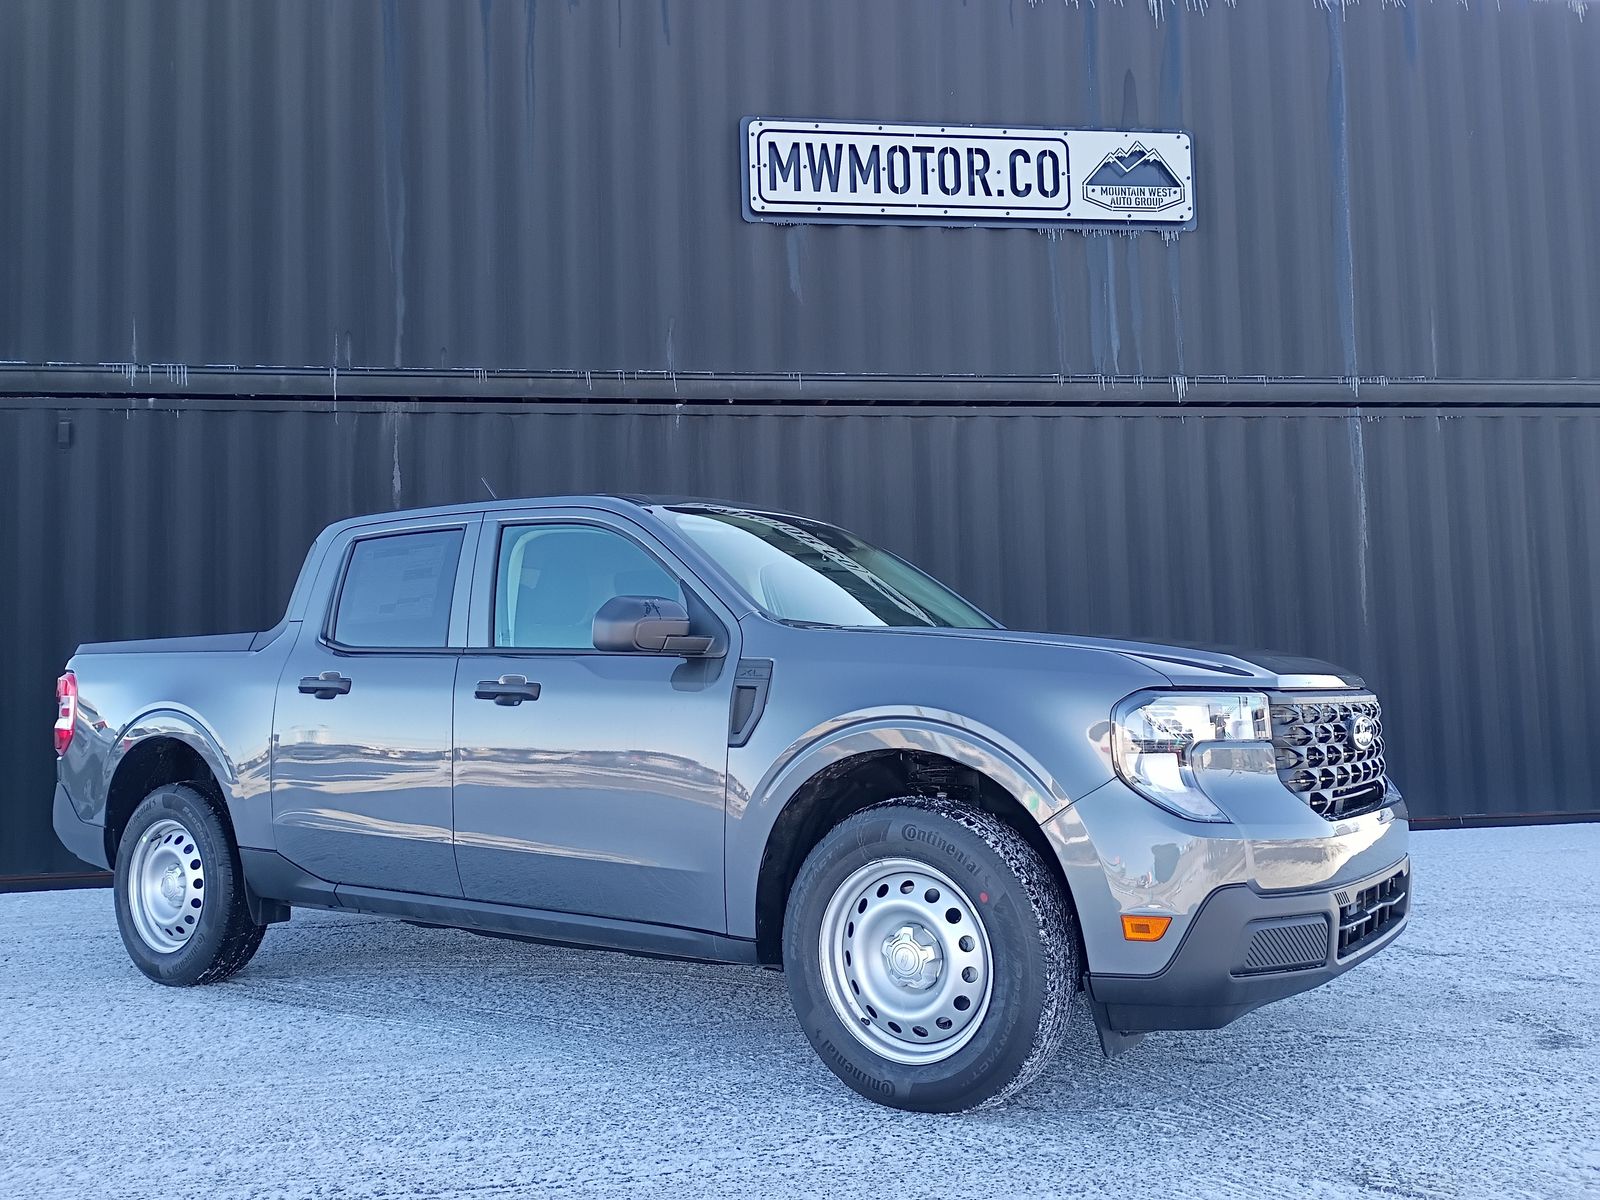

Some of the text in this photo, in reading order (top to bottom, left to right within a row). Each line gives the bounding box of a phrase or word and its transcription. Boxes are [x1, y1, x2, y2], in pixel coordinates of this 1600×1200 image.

[767, 141, 1061, 199] MWMOTOR.CO
[1100, 186, 1172, 197] MOUNTAIN WEST
[1110, 196, 1164, 207] AUTO GROUP
[901, 823, 982, 877] Continental
[822, 1039, 896, 1098] Continental
